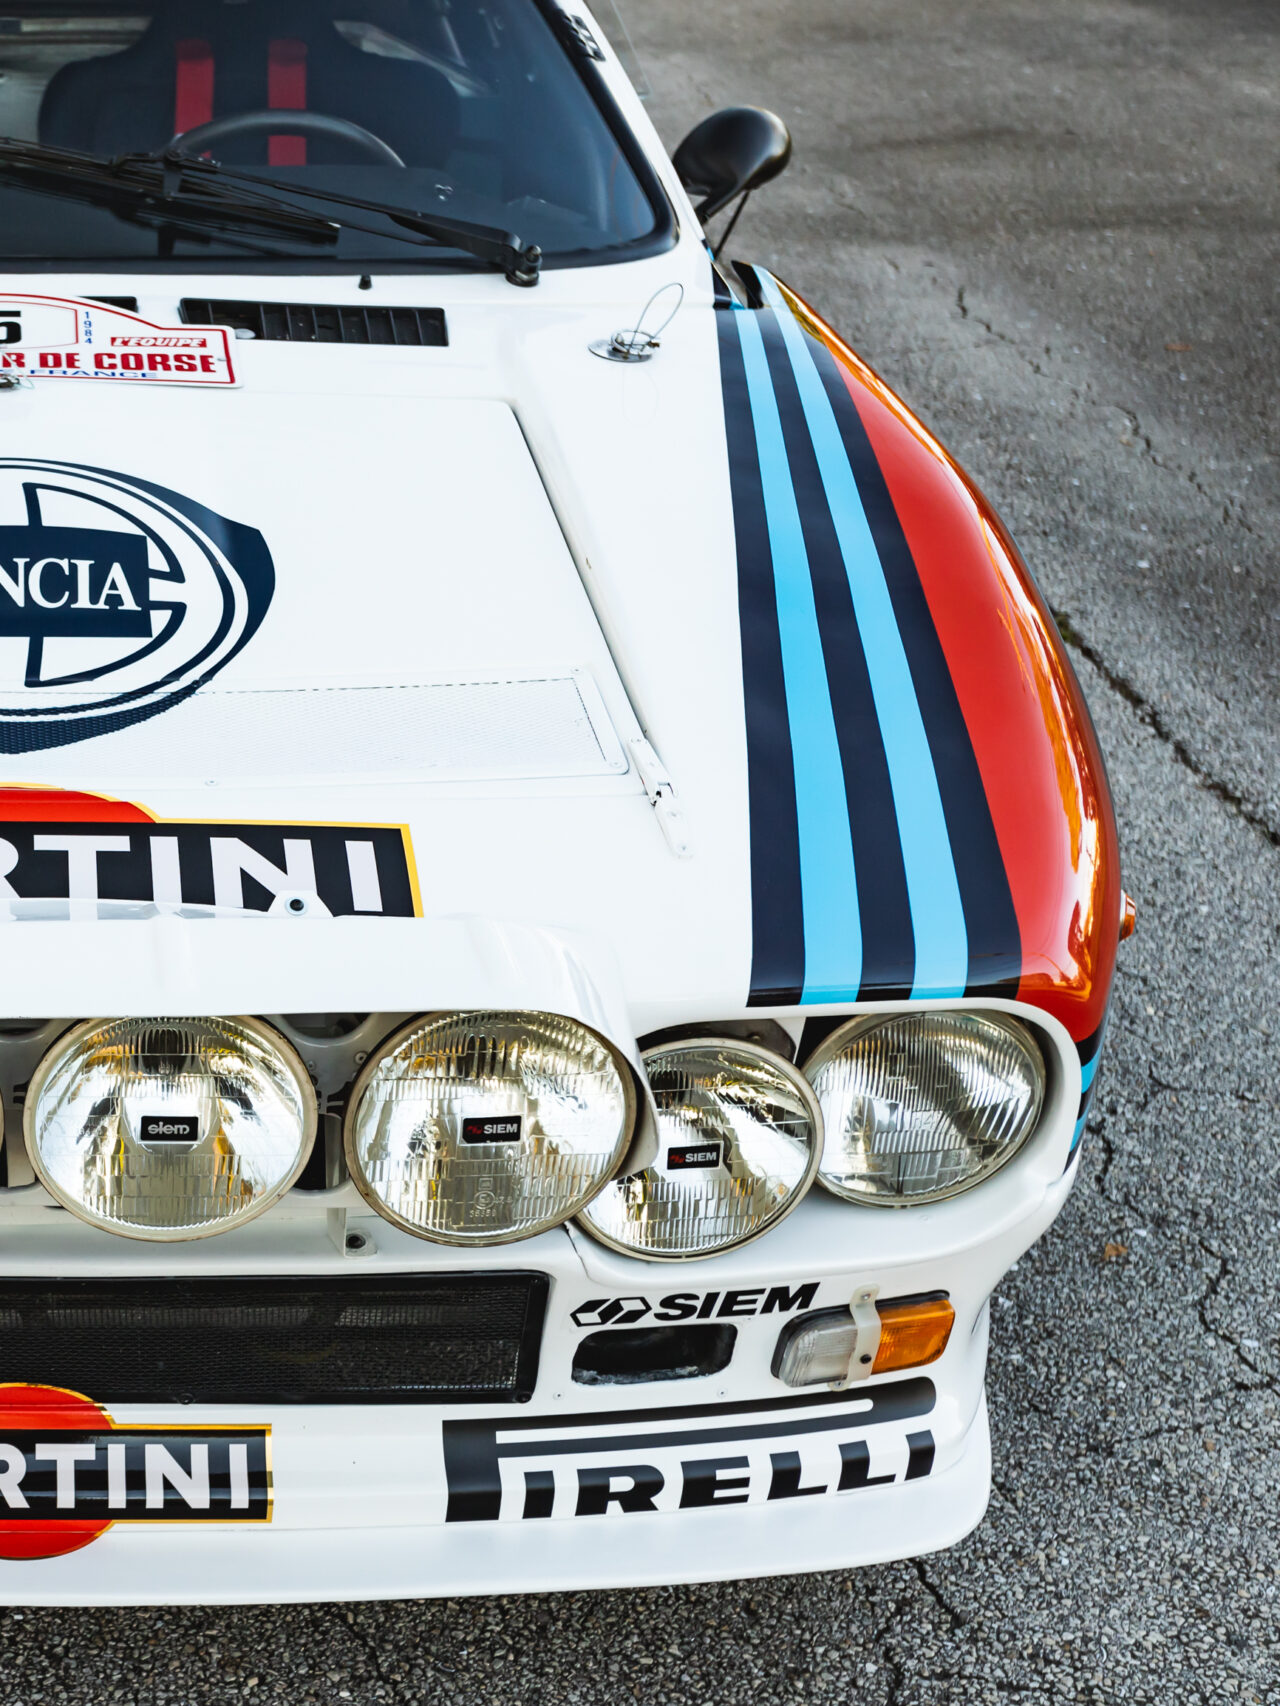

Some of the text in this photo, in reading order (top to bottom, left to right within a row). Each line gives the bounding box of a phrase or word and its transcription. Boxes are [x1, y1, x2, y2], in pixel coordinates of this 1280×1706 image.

[84, 311, 93, 344] 1984
[39, 353, 81, 369] DE
[94, 353, 217, 372] CORSE
[30, 369, 158, 378] FRANCE
[483, 1123, 518, 1134] SIEM
[684, 1151, 717, 1163] SIEM
[653, 1282, 821, 1321] SIEM
[442, 1376, 937, 1523] PIRELLI
